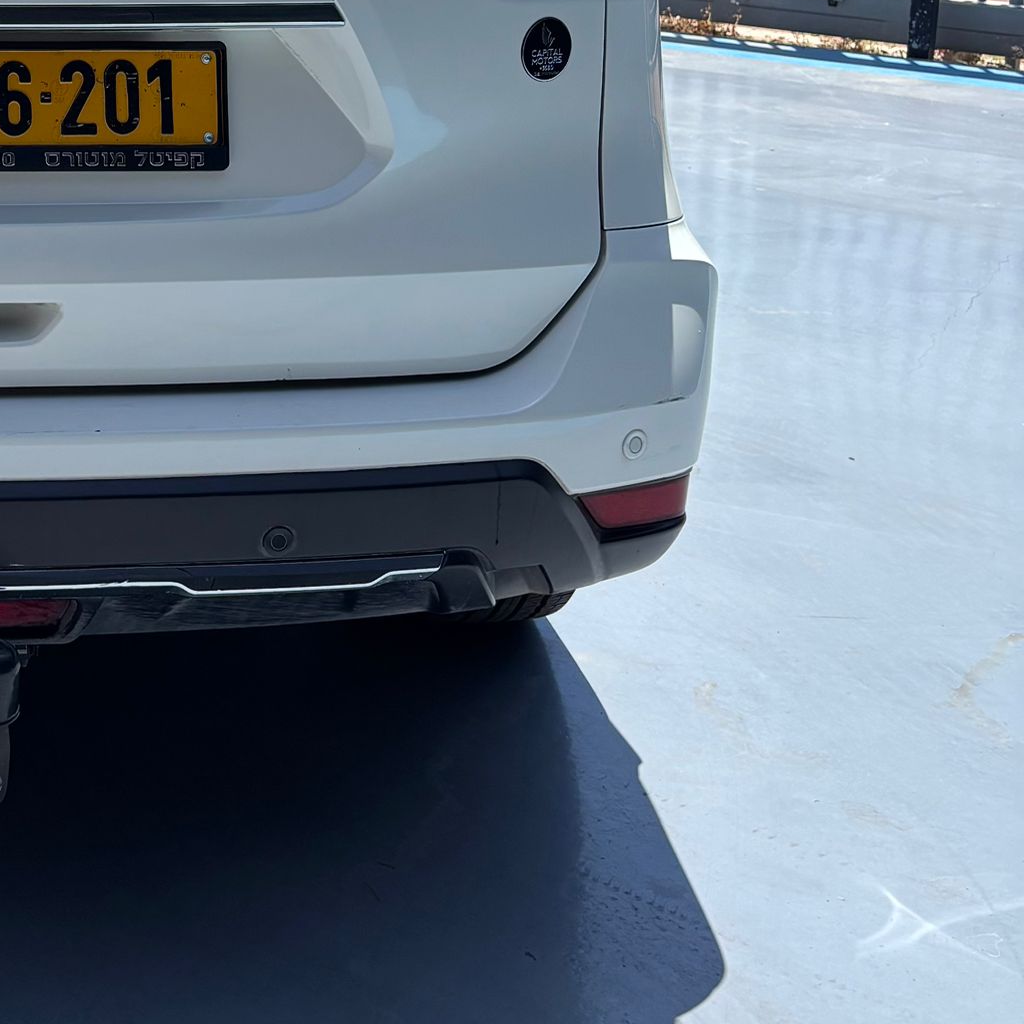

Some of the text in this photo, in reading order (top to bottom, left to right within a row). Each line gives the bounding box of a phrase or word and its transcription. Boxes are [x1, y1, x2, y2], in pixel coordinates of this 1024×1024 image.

[531, 48, 564, 58] CAPITAL
[531, 56, 563, 66] MOTORS
[44, 149, 205, 170] קפיטל מוטורס
